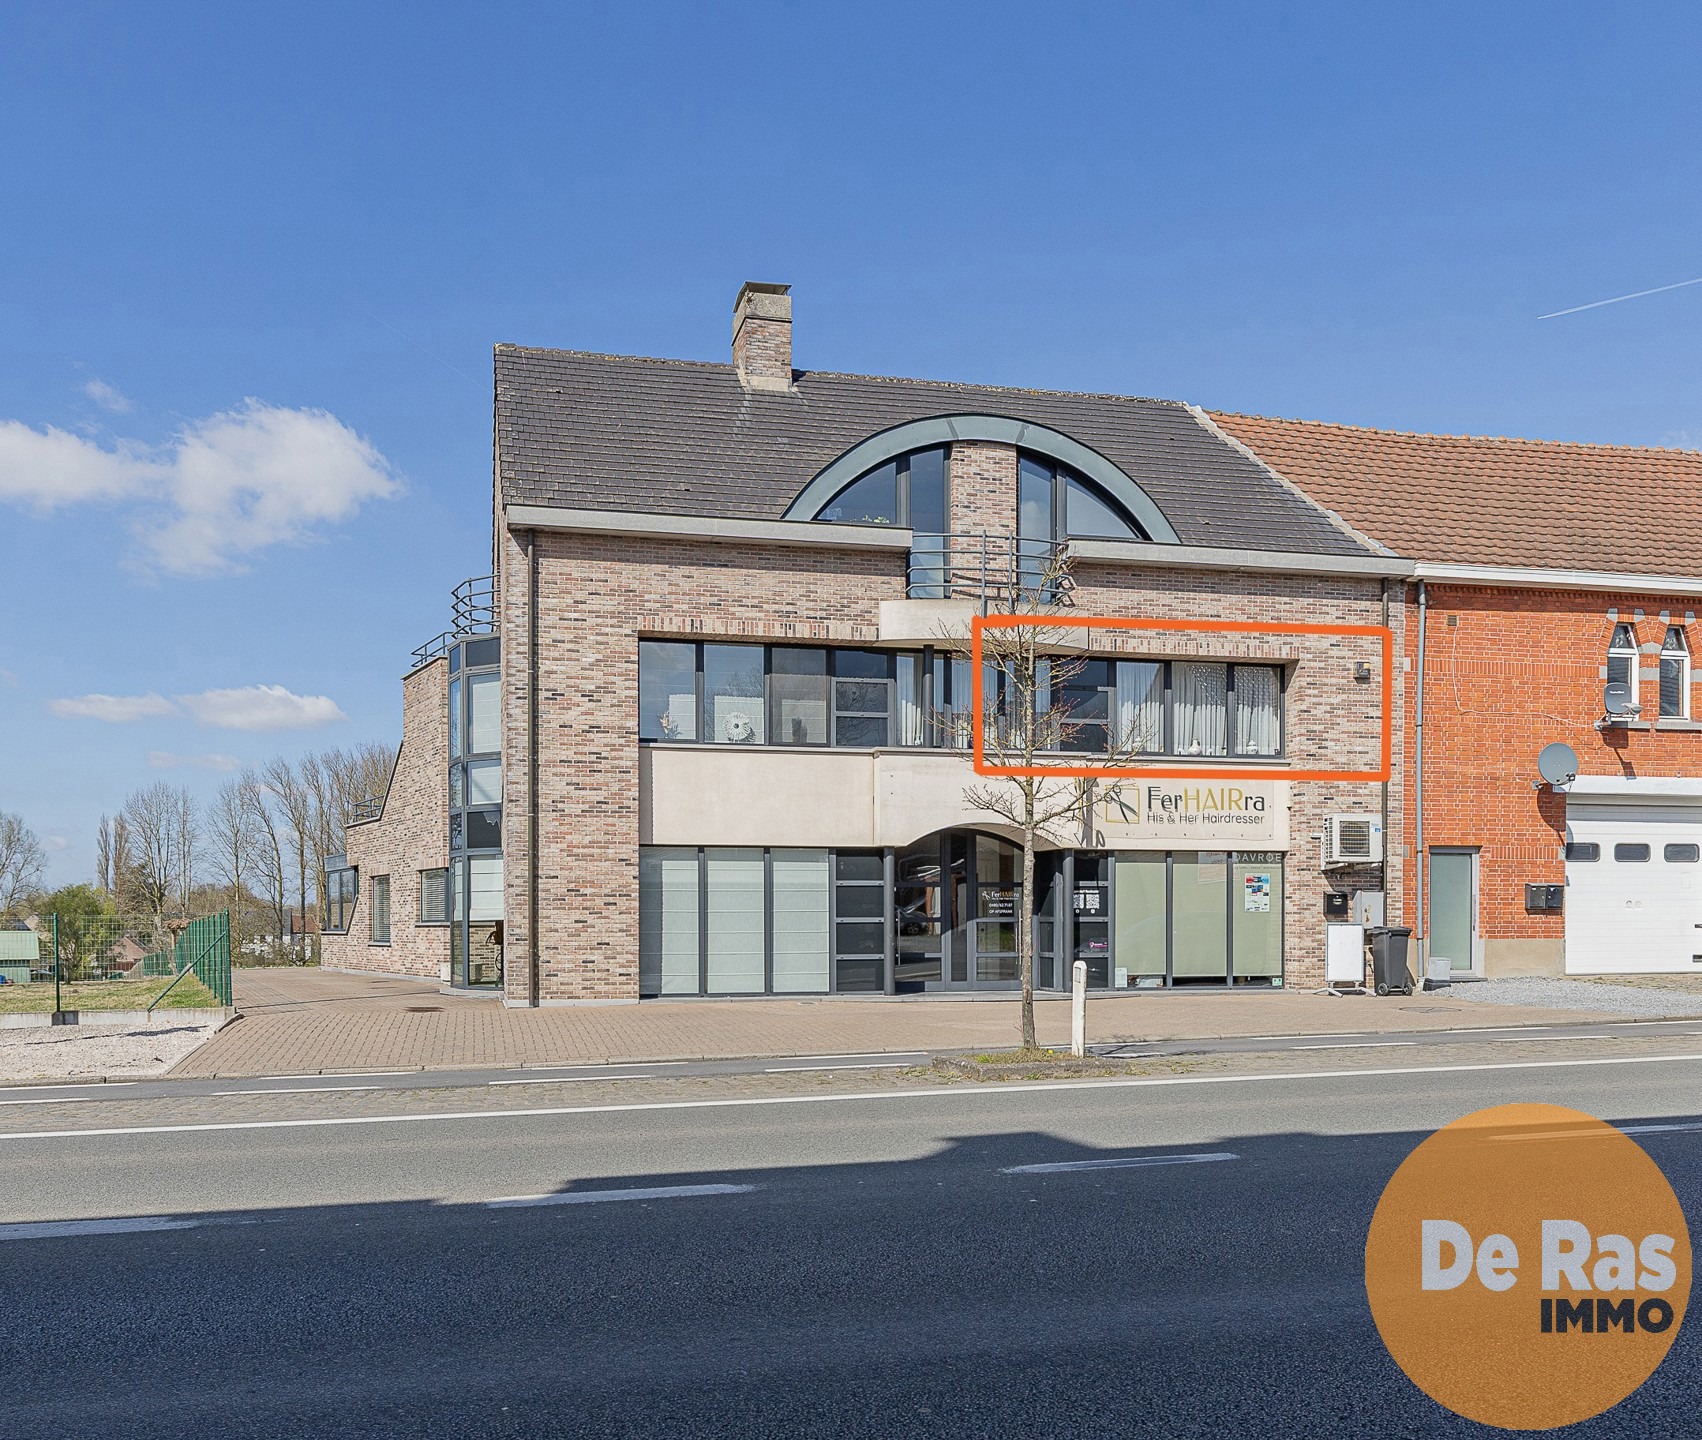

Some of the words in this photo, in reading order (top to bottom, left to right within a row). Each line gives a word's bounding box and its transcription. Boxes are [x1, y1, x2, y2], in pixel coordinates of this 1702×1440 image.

[1147, 786, 1265, 812] FerHAIRra
[1147, 812, 1164, 824] His
[1166, 811, 1176, 825] &
[1179, 812, 1199, 824] Her
[1202, 812, 1265, 824] Hairdresser
